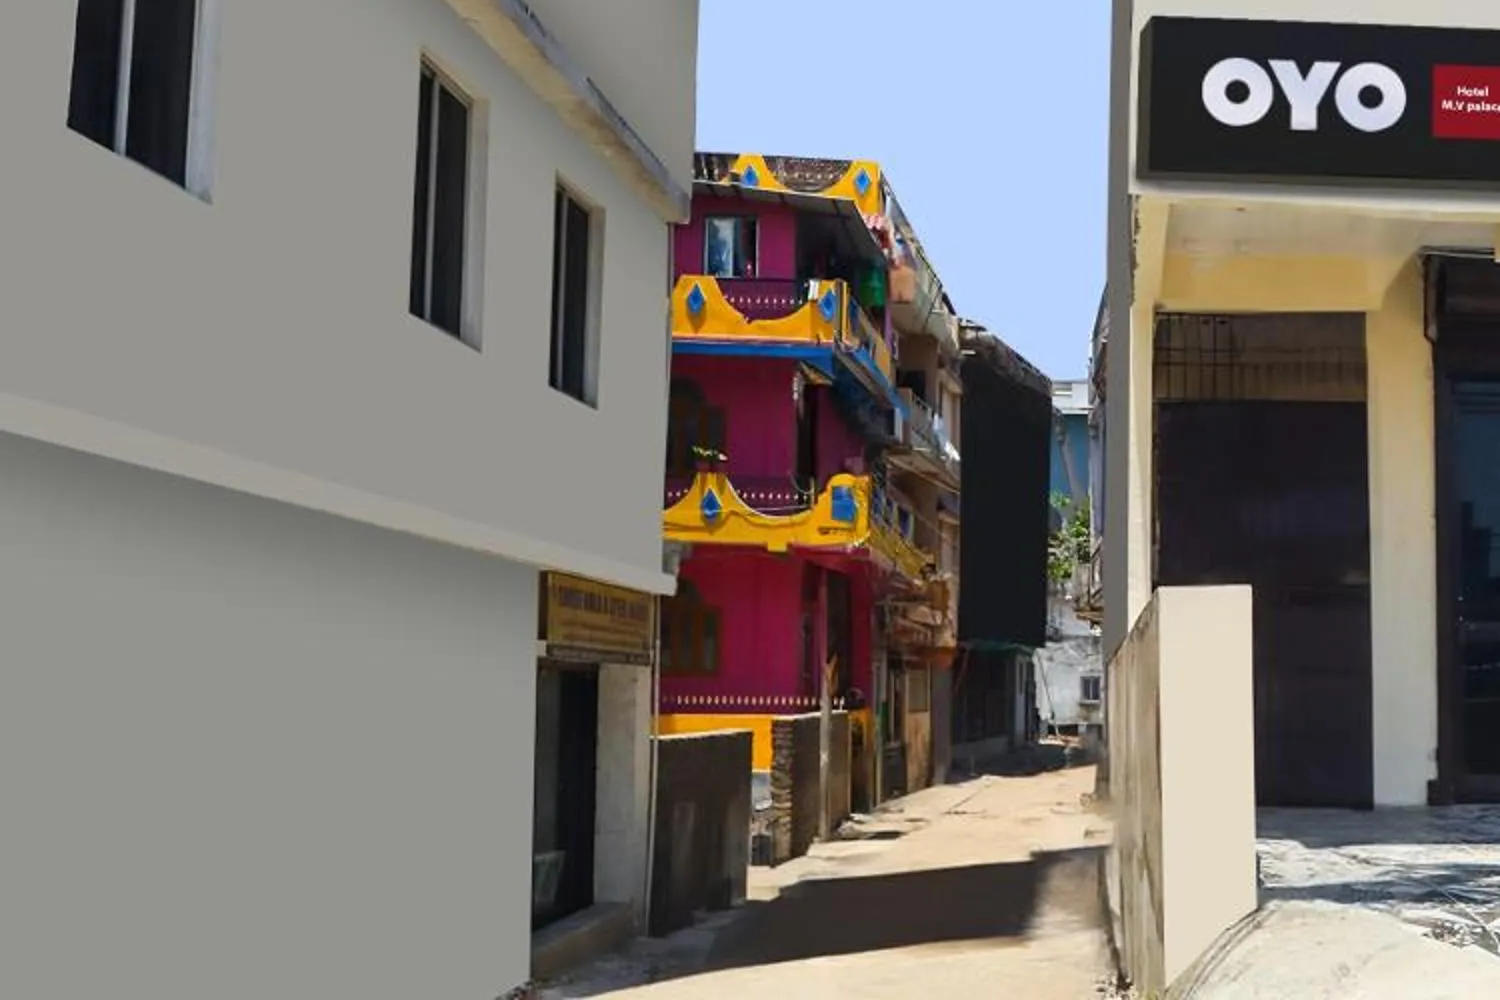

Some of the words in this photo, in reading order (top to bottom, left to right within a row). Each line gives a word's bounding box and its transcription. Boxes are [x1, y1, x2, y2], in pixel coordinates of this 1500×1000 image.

[1201, 57, 1407, 133] OYO
[1457, 85, 1489, 97] Hotel
[1441, 99, 1465, 111] M.V
